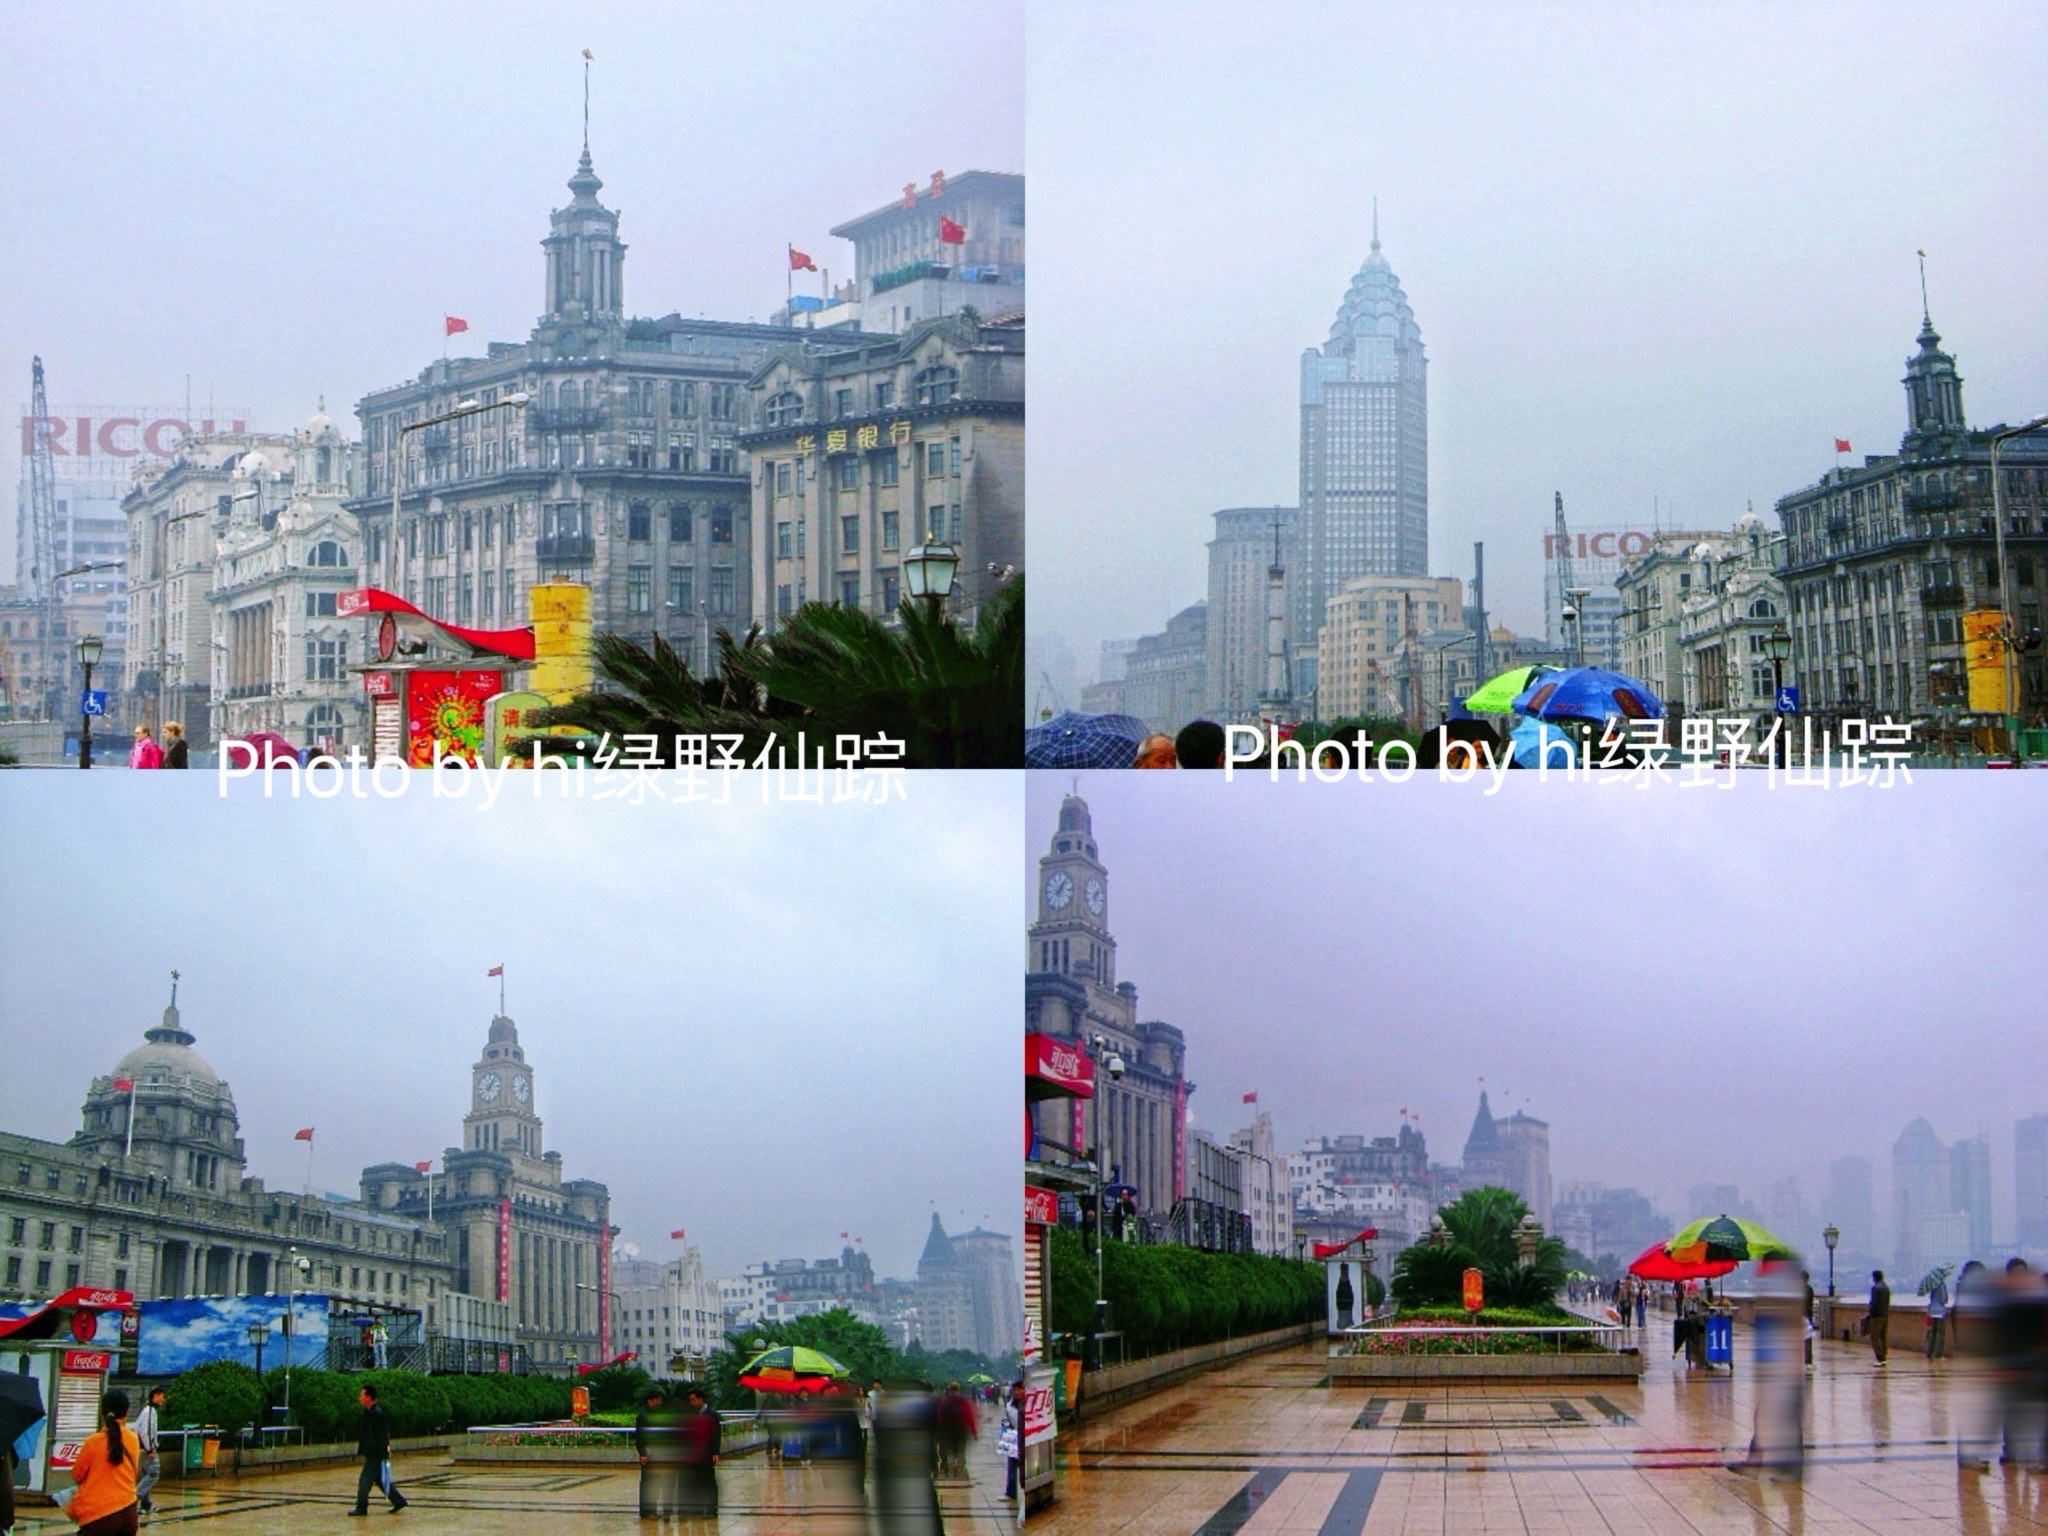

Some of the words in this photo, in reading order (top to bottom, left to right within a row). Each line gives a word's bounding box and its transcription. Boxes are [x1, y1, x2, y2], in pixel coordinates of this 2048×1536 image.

[796, 420, 912, 456] 华夏银行
[1710, 1329, 1728, 1350] 11
